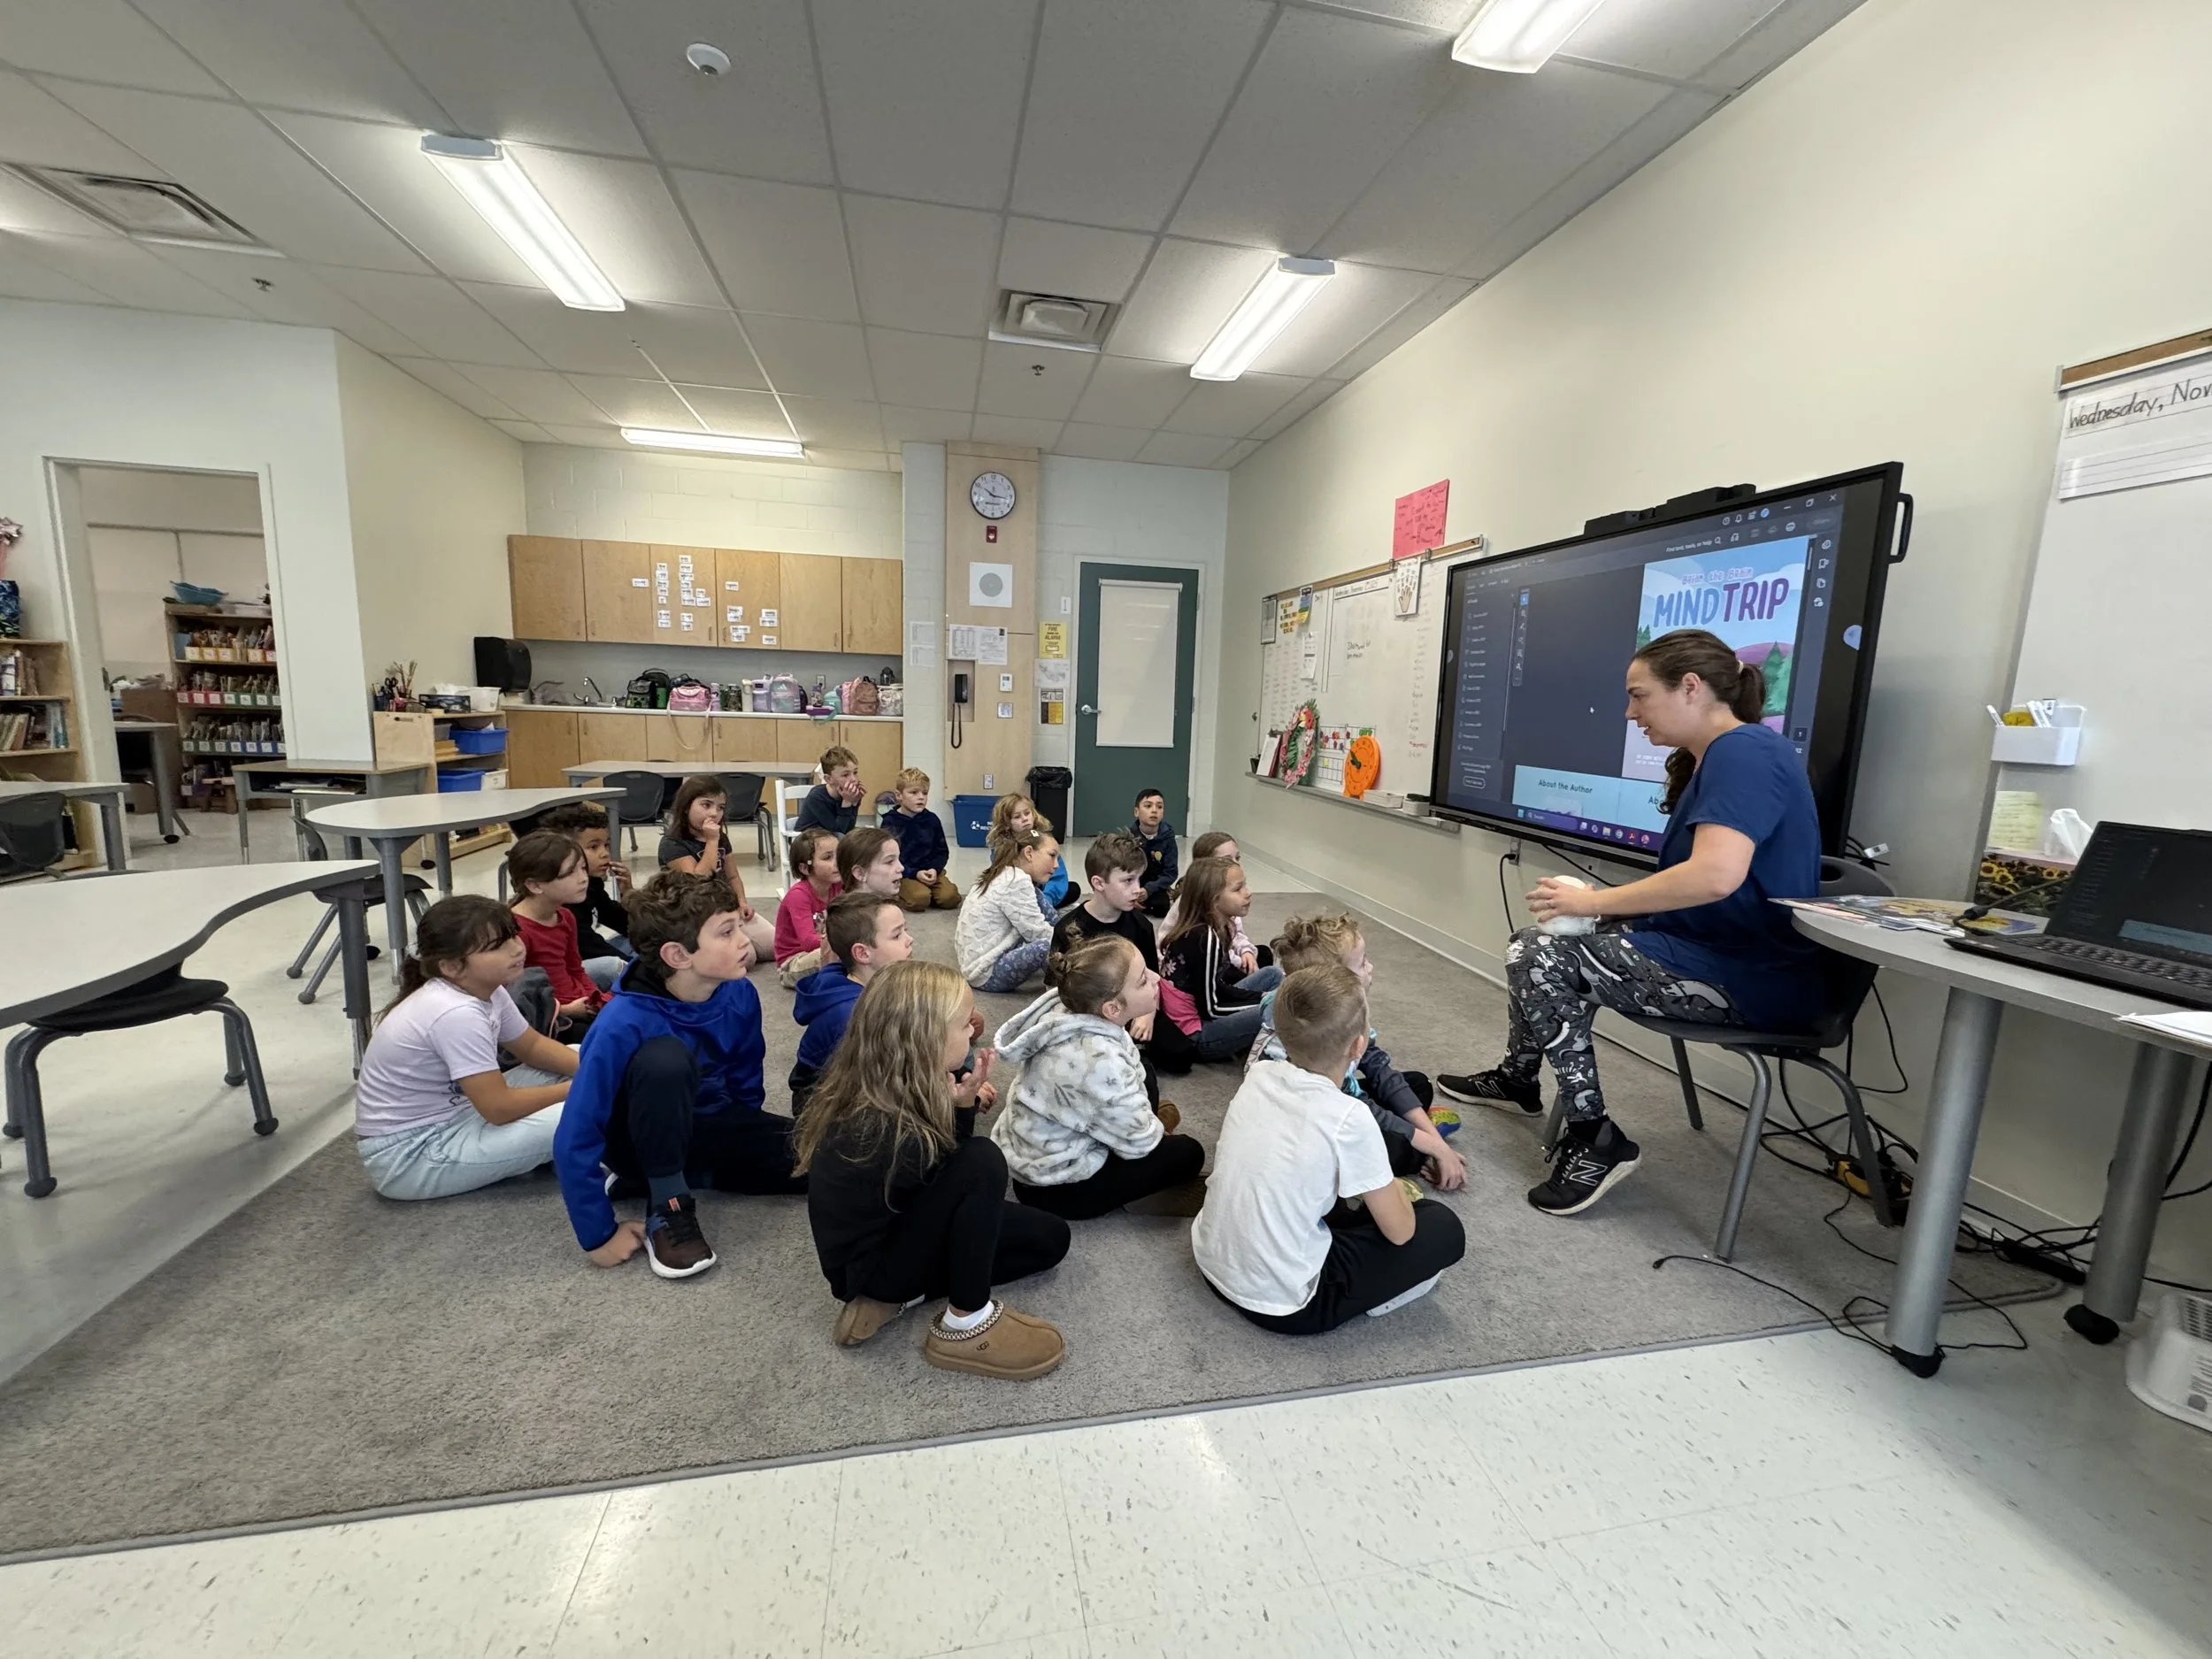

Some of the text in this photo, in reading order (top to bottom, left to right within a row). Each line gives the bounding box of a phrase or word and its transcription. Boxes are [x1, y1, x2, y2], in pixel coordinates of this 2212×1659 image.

[2069, 379, 2212, 428] Wednesday, Nov
[1653, 578, 1790, 628] MIND TRIP
[1539, 780, 1557, 789] About
[1571, 785, 1593, 794] Author
